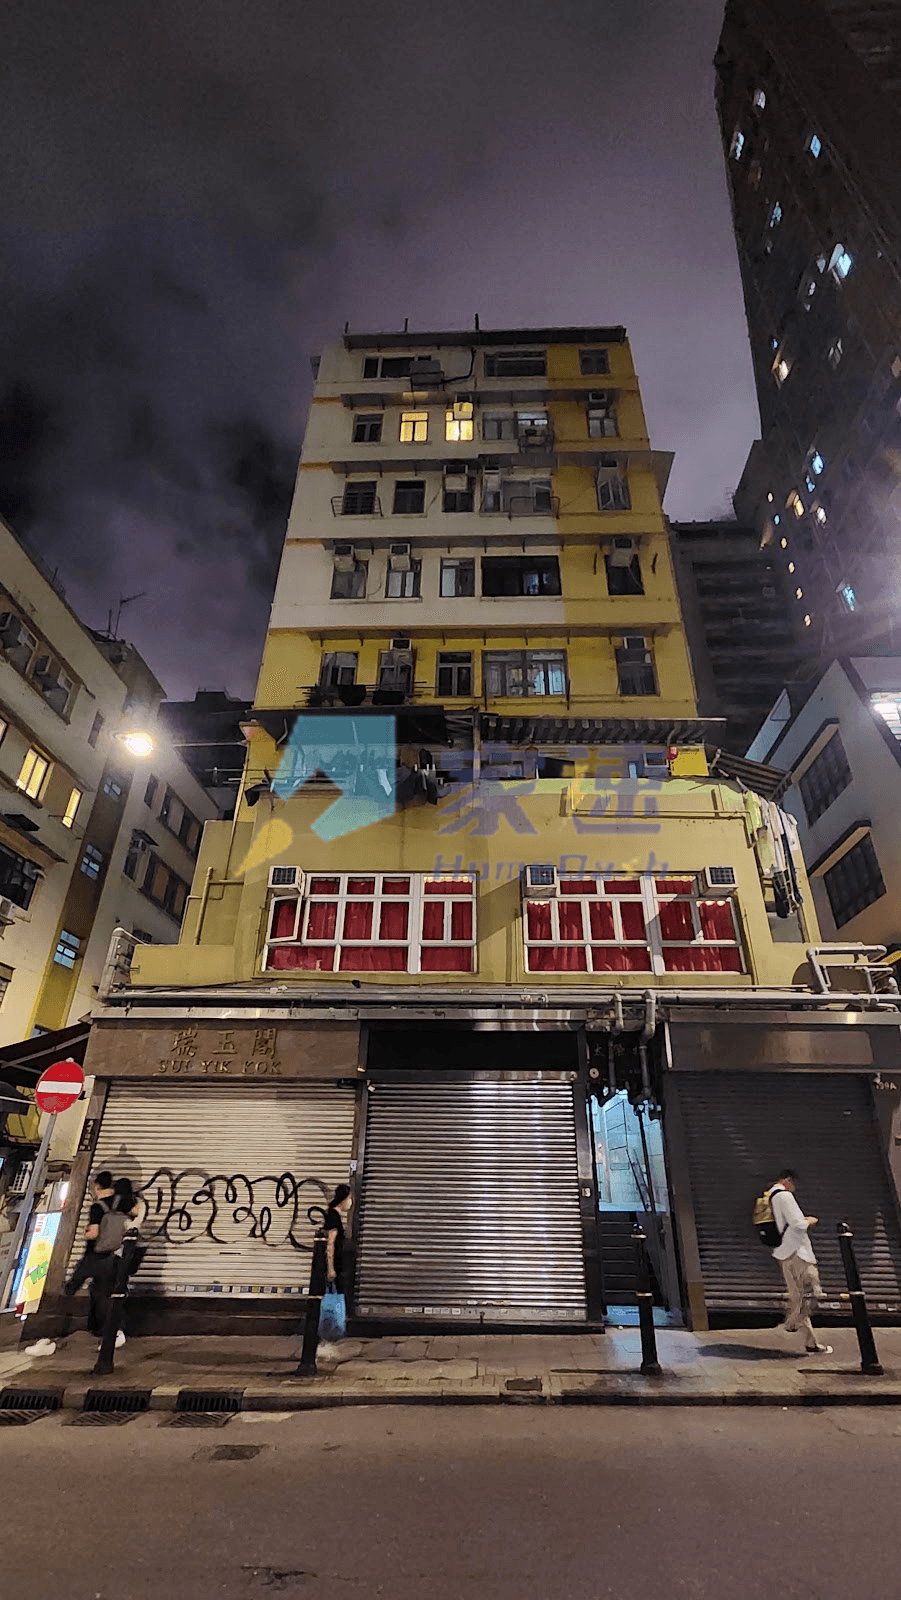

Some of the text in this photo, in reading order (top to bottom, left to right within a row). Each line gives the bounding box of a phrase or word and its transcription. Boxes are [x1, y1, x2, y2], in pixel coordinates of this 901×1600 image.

[159, 1059, 281, 1074] SUI YIK KOK
